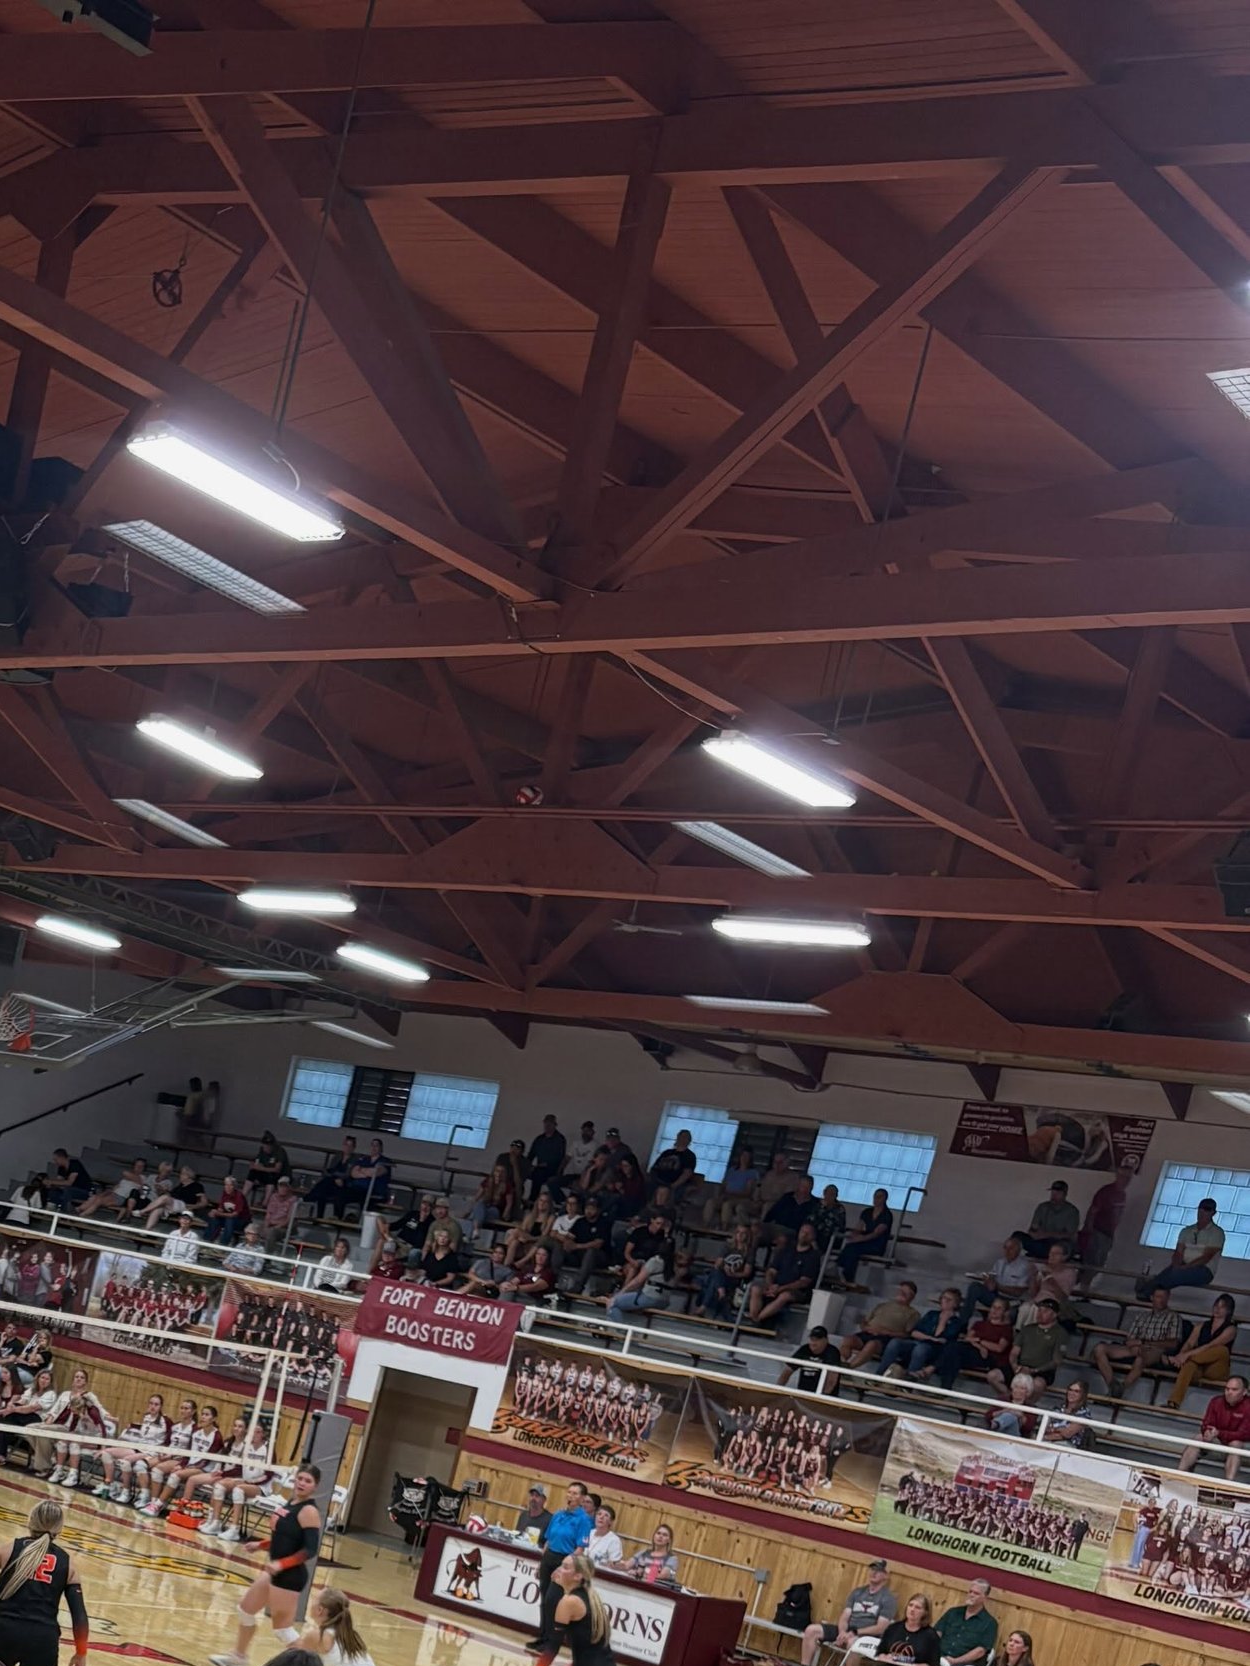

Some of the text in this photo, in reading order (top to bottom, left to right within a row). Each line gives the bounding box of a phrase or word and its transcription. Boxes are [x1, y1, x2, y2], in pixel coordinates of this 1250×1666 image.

[380, 1286, 505, 1326] FORT BENTON
[113, 1333, 174, 1356] LONGHORN GOLF
[385, 1315, 476, 1351] BOOSTERS
[513, 1429, 638, 1472] LONGHORN BASKETBALL
[906, 1525, 979, 1559] LONGHORN
[981, 1544, 1052, 1574] FOOTBALL
[1134, 1583, 1219, 1615] LONGHORN
